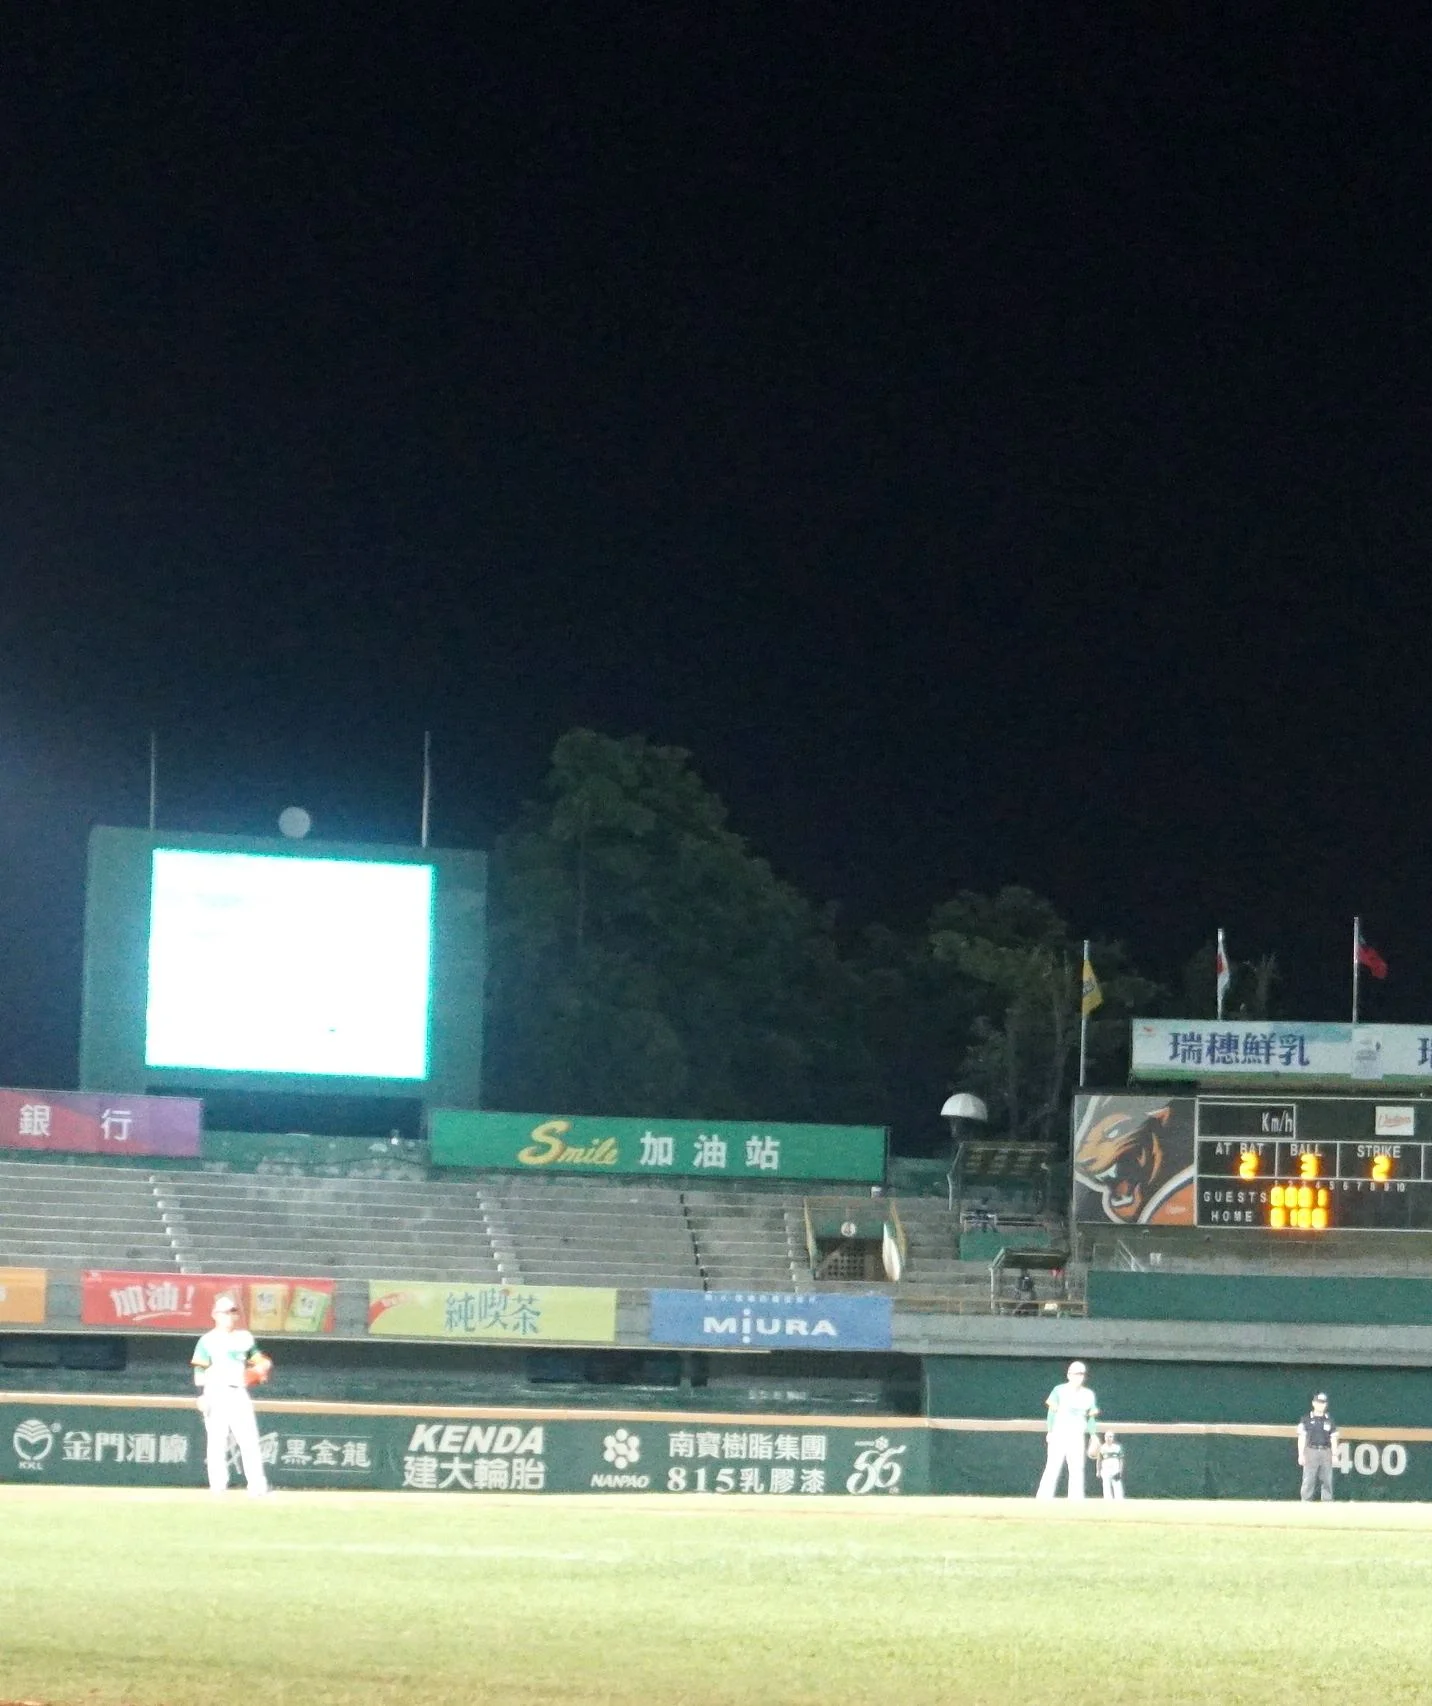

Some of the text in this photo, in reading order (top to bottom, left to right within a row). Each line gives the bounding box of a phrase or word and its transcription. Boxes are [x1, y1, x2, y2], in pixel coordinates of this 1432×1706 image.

[1168, 1032, 1311, 1067] 瑞穗鮮乳
[19, 1104, 133, 1141] 銀行
[1262, 1111, 1293, 1133] Km/h
[517, 1120, 781, 1171] Smile 加油站
[1215, 1142, 1264, 1157] AT BAT
[1290, 1144, 1323, 1157] BALL
[1357, 1145, 1401, 1159] STRIKE
[1203, 1191, 1267, 1204] GUESTS
[1211, 1210, 1253, 1223] HOME
[445, 1287, 541, 1336] 純喫茶
[408, 1424, 545, 1454] KENDA
[668, 1431, 828, 1460] 南寶樹脂集團
[403, 1457, 545, 1490] 建大輪胎
[1331, 1442, 1407, 1476] 400
[590, 1473, 650, 1489] NANPAO
